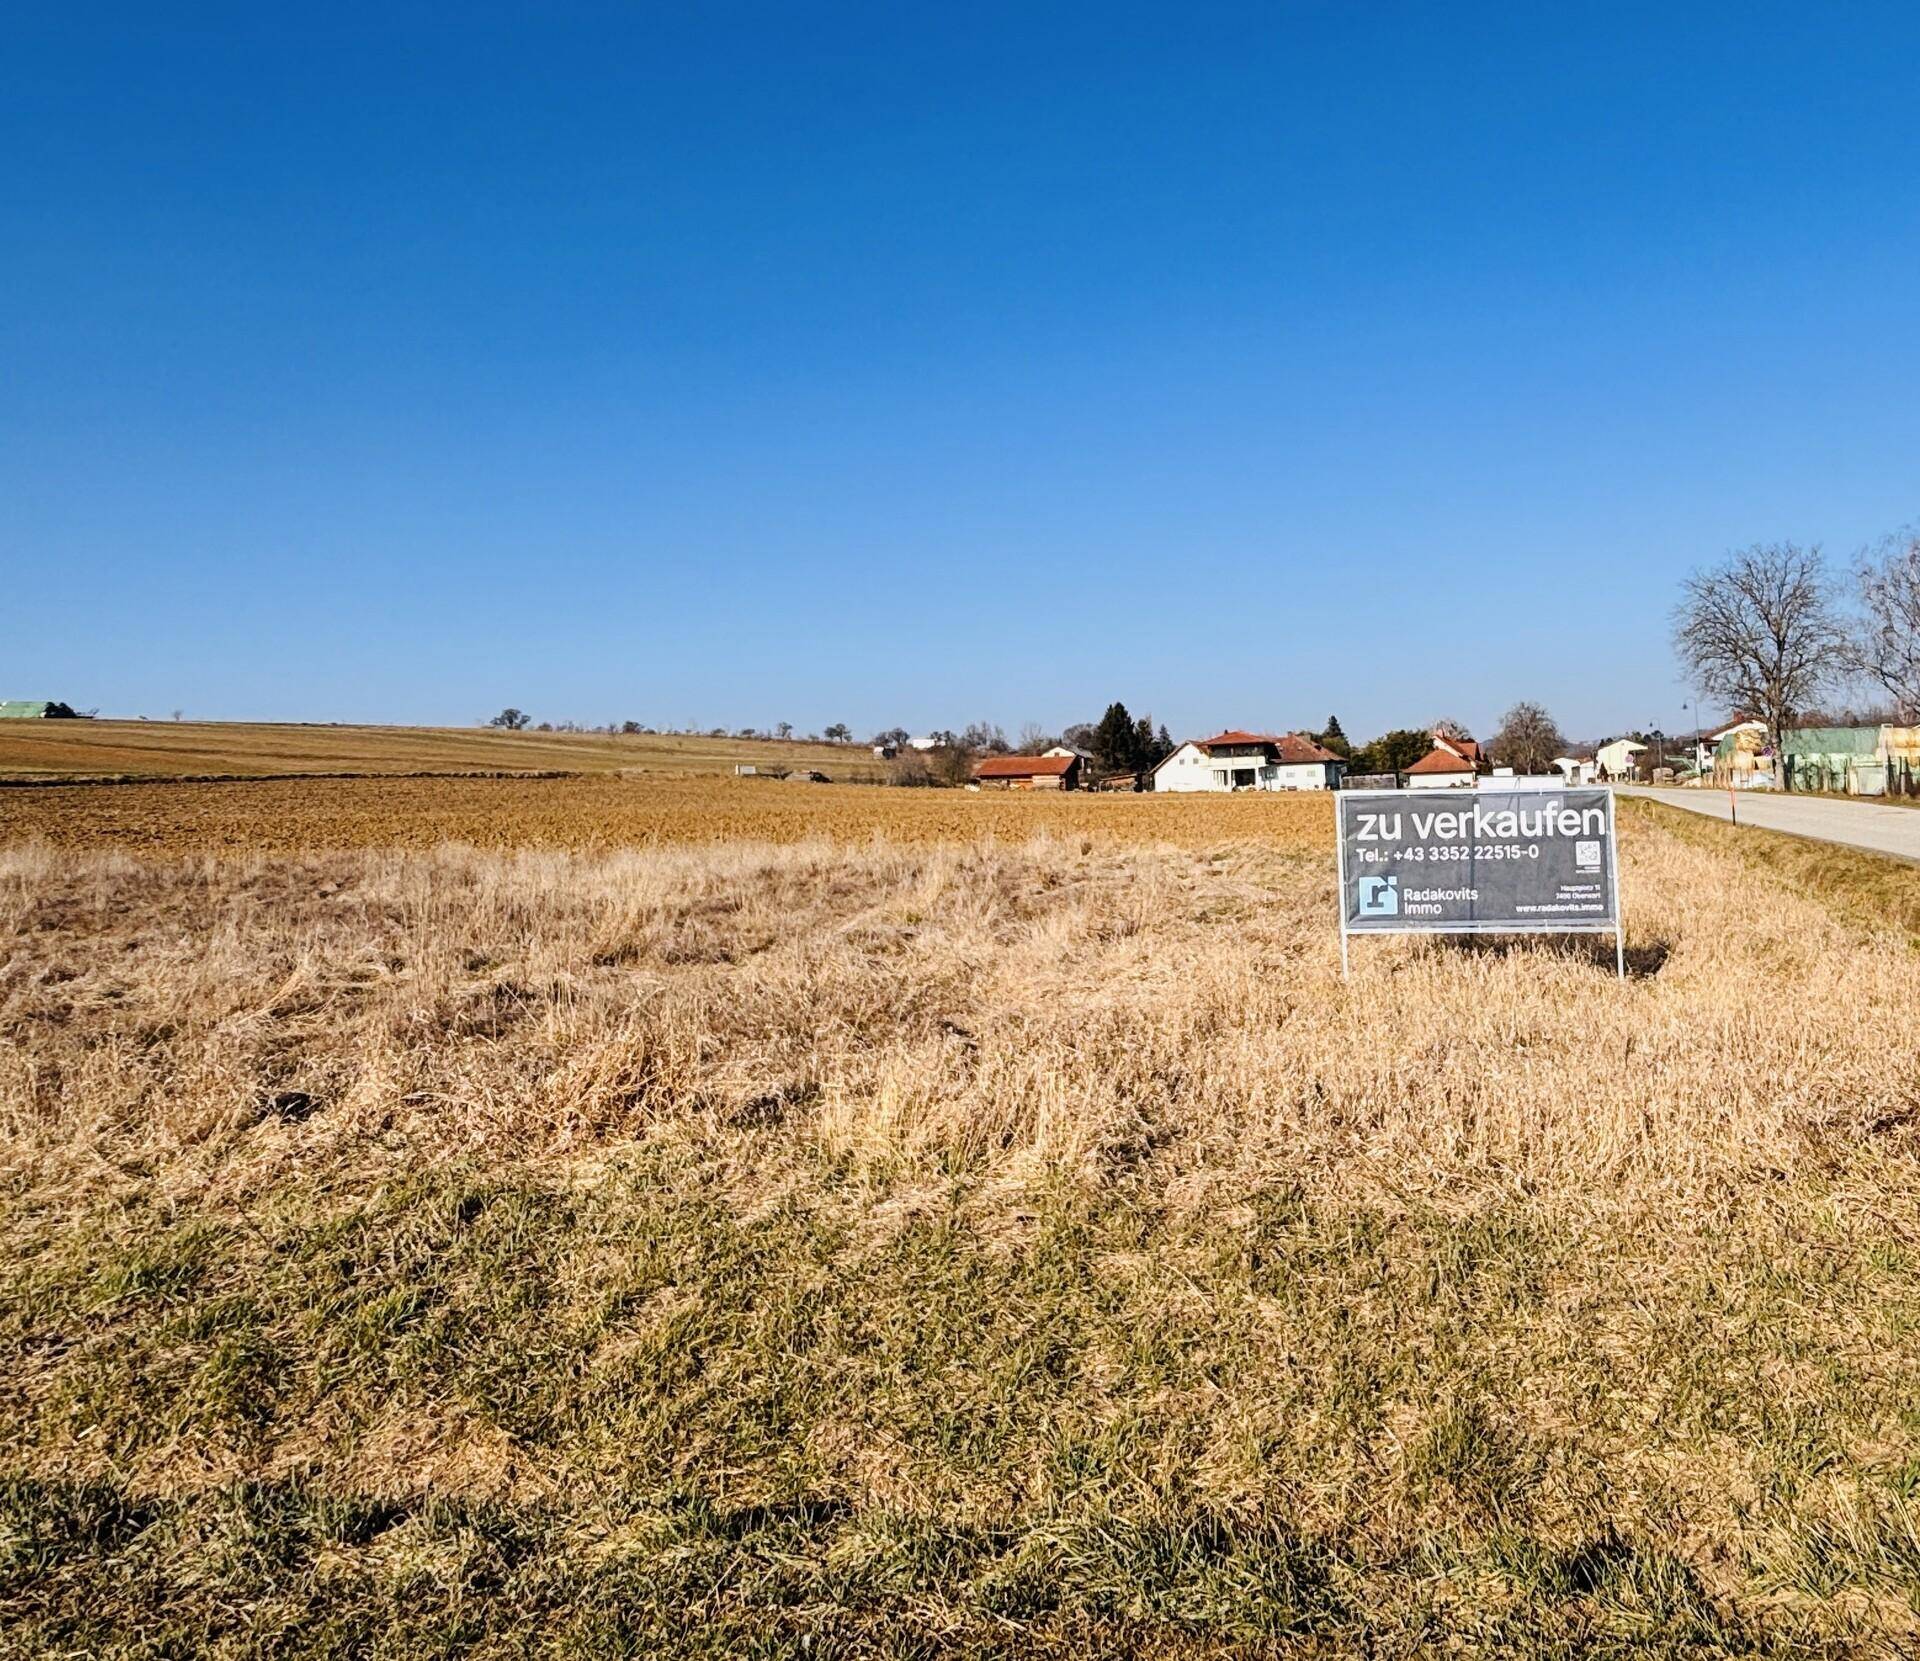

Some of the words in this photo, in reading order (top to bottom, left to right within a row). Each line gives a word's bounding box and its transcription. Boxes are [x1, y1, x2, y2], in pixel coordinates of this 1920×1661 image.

[1357, 813, 1402, 840] zu
[1411, 801, 1606, 840] verkaufen
[1356, 848, 1389, 862] Tel.:
[1393, 847, 1425, 861] +43
[1428, 846, 1470, 860] 3352
[1474, 844, 1539, 859] 22515-0
[1403, 887, 1479, 901] Radakovits
[1404, 902, 1442, 915] Immo
